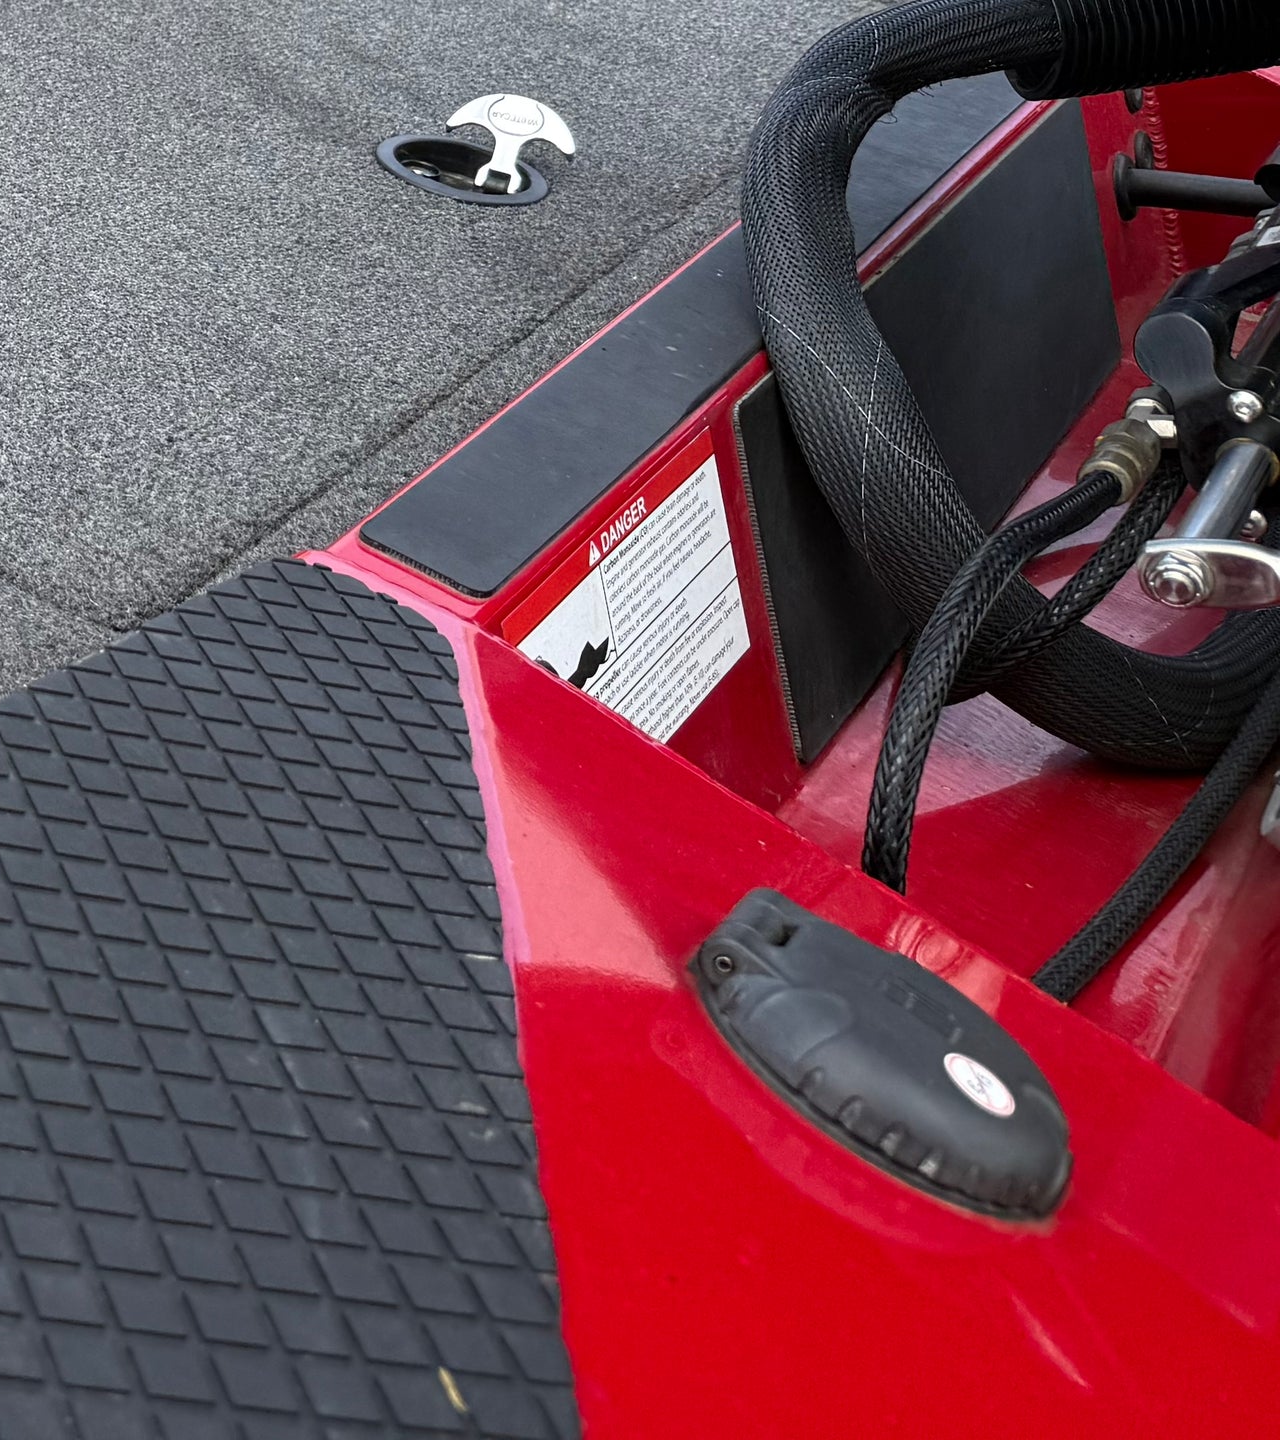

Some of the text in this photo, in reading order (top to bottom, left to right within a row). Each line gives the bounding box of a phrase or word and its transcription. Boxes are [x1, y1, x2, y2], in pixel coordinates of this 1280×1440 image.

[599, 494, 646, 555] DANGER
[619, 560, 628, 575] and
[691, 490, 699, 505] and
[646, 568, 654, 582] the
[631, 597, 642, 615] Move
[599, 665, 621, 697] propeller
[621, 658, 629, 672] can
[629, 644, 642, 663] cause
[641, 627, 657, 649] serious
[656, 613, 670, 636] injury
[621, 673, 629, 687] use
[628, 656, 643, 679] ladder
[642, 643, 655, 664] when
[655, 629, 668, 650] motor
[654, 686, 672, 714] smoking
[676, 672, 687, 690] open
